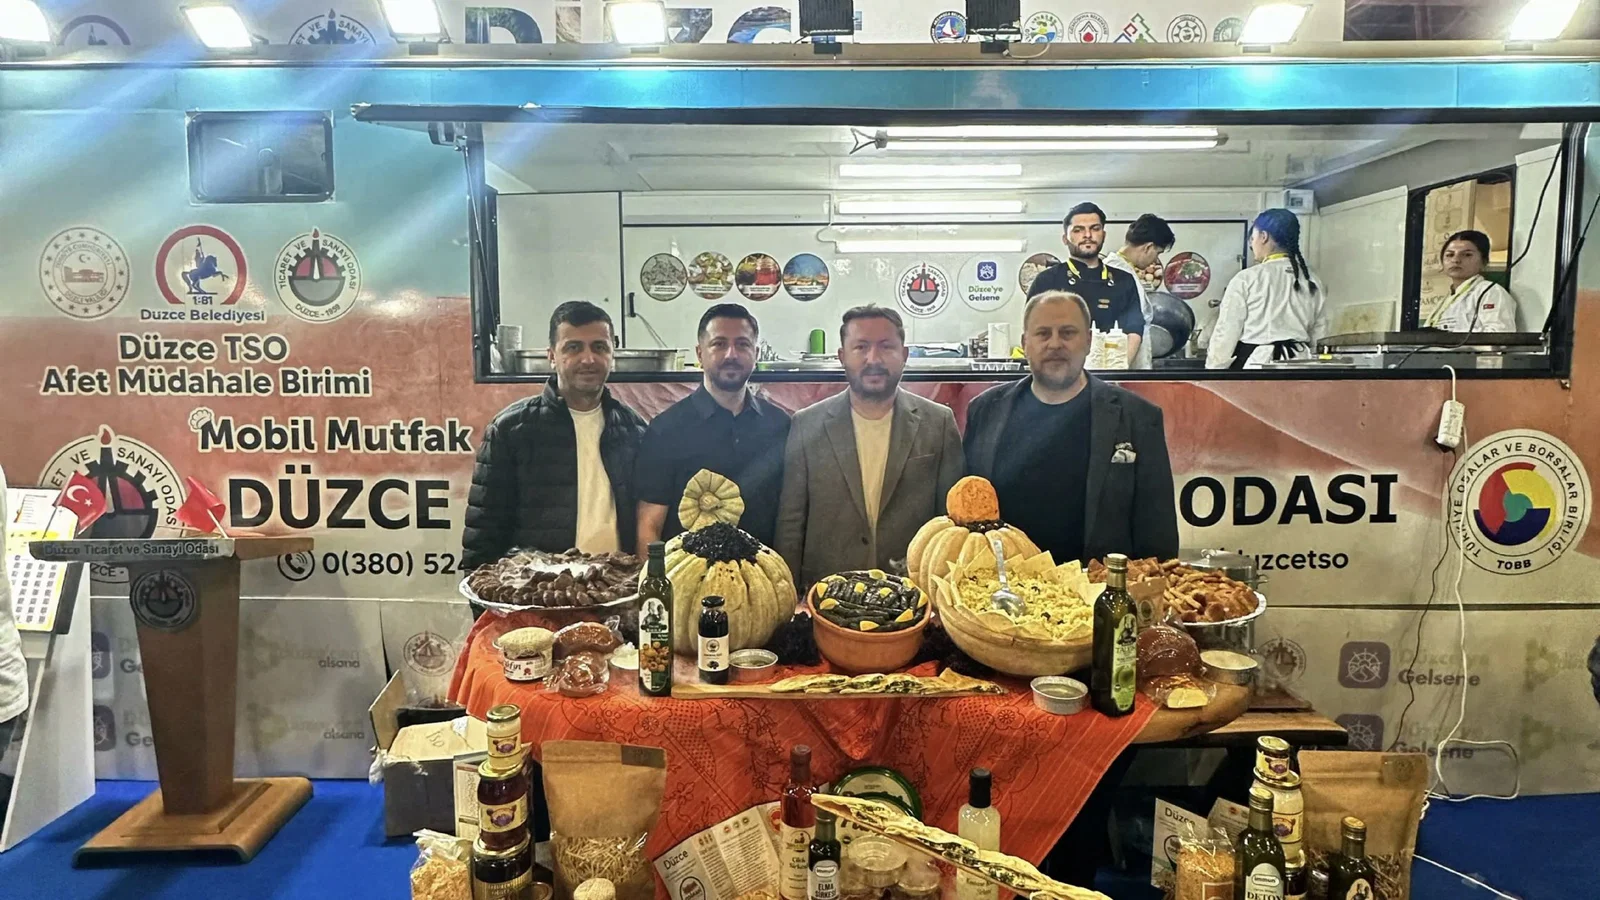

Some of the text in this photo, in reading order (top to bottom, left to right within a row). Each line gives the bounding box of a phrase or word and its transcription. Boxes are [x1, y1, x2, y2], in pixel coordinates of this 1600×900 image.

[308, 21, 323, 33] VE
[278, 239, 357, 290] TİCARET VE SANAYİ ODASI
[968, 285, 1004, 295] Düzce'ye
[968, 293, 1001, 302] Gelsene
[193, 296, 213, 306] 1:81
[294, 302, 320, 318] DÜZCE
[190, 309, 265, 324] Belediyesi
[119, 334, 289, 362] Düzce TSO
[42, 367, 372, 396] Afet Müdahale Birimi
[200, 416, 473, 454] Mobil Mutfak
[1504, 442, 1523, 453] VE
[1528, 443, 1579, 500] BORSALAR
[70, 449, 91, 464] VE
[117, 447, 168, 483] SANAYİ
[160, 484, 178, 527] ODAS
[229, 464, 452, 530] DÜZCE
[1180, 474, 1398, 527] ODASI
[84, 543, 125, 555] Ticaret
[126, 546, 141, 555] ve
[143, 543, 184, 557] Sanayi
[185, 542, 220, 556] Odası
[322, 550, 414, 577] 0(380)
[1496, 559, 1532, 570] TOBB
[1397, 668, 1481, 687] Gelsene
[663, 850, 689, 870] Düzce
[818, 883, 834, 891] ELMA
